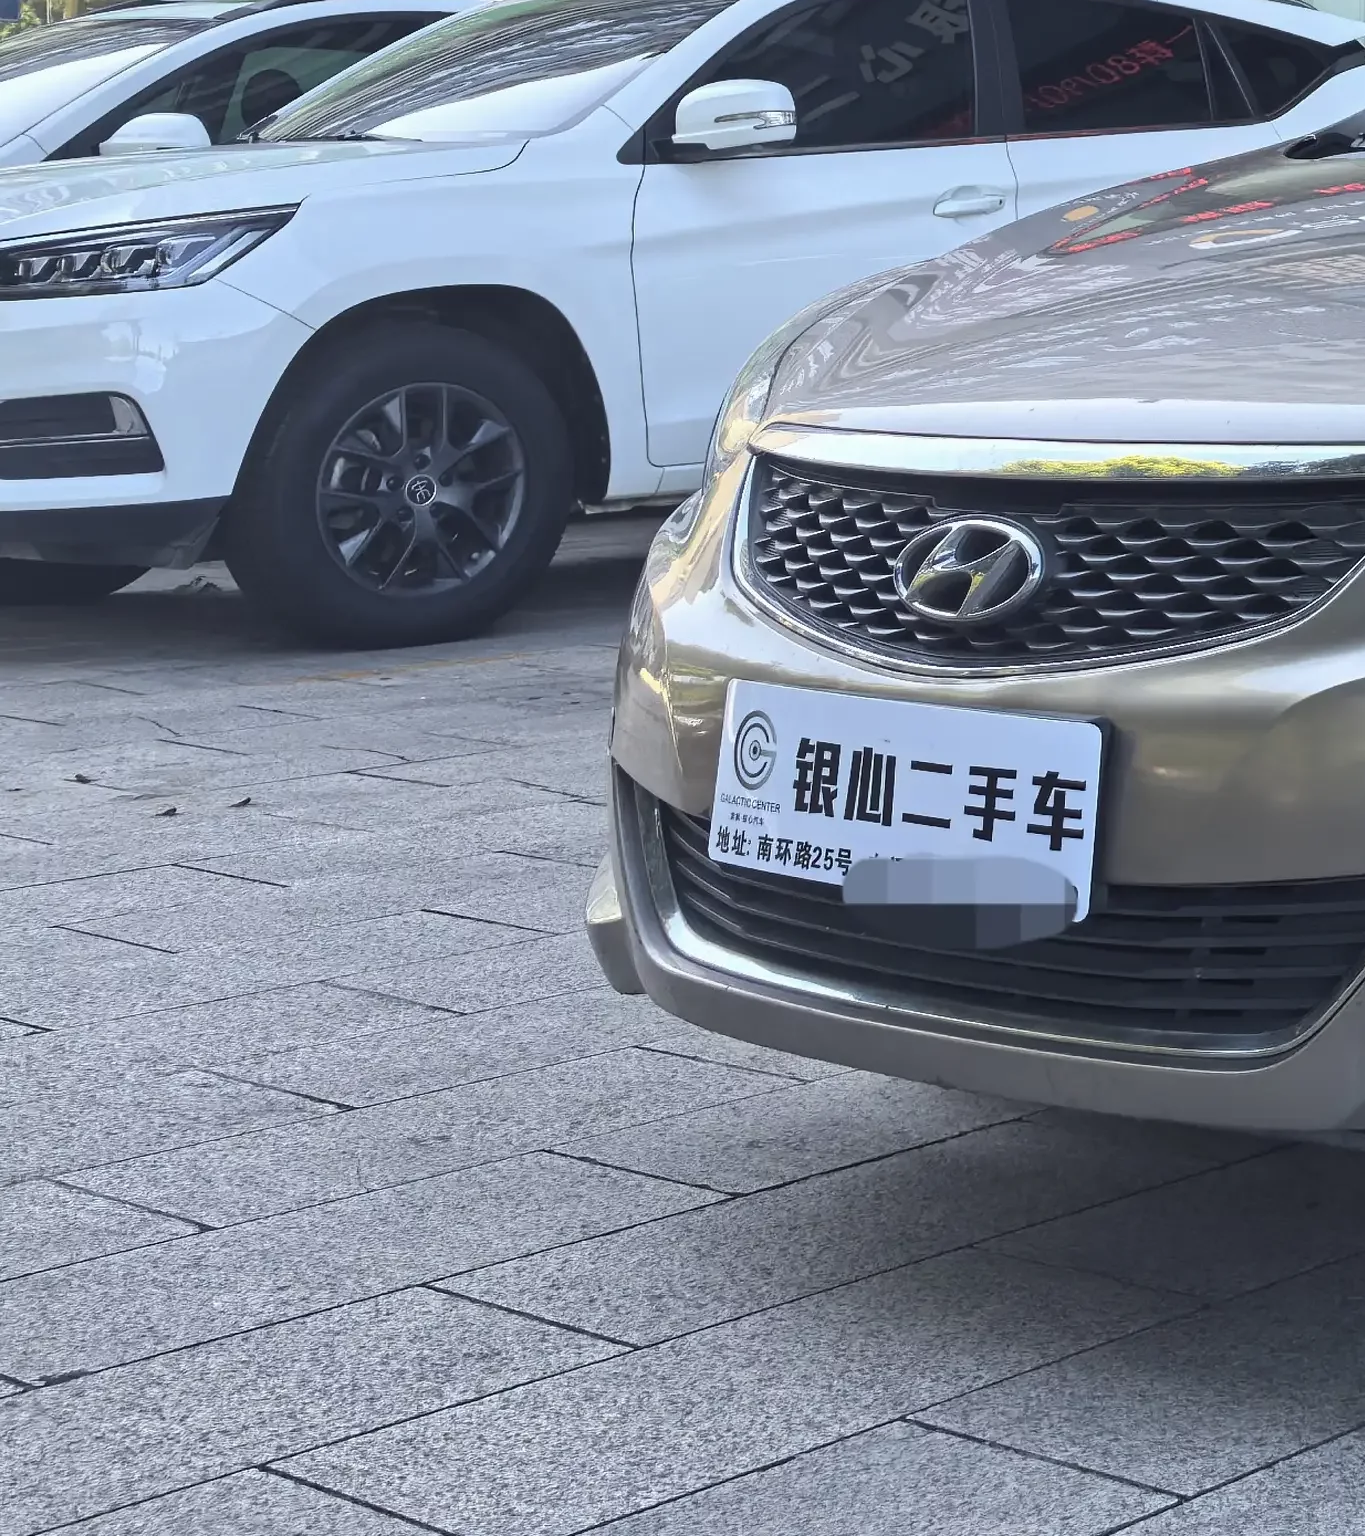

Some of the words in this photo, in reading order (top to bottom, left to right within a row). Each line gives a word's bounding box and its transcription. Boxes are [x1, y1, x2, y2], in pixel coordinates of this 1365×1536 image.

[751, 799, 781, 814] CENTER
[792, 736, 1087, 852] 银心二手车
